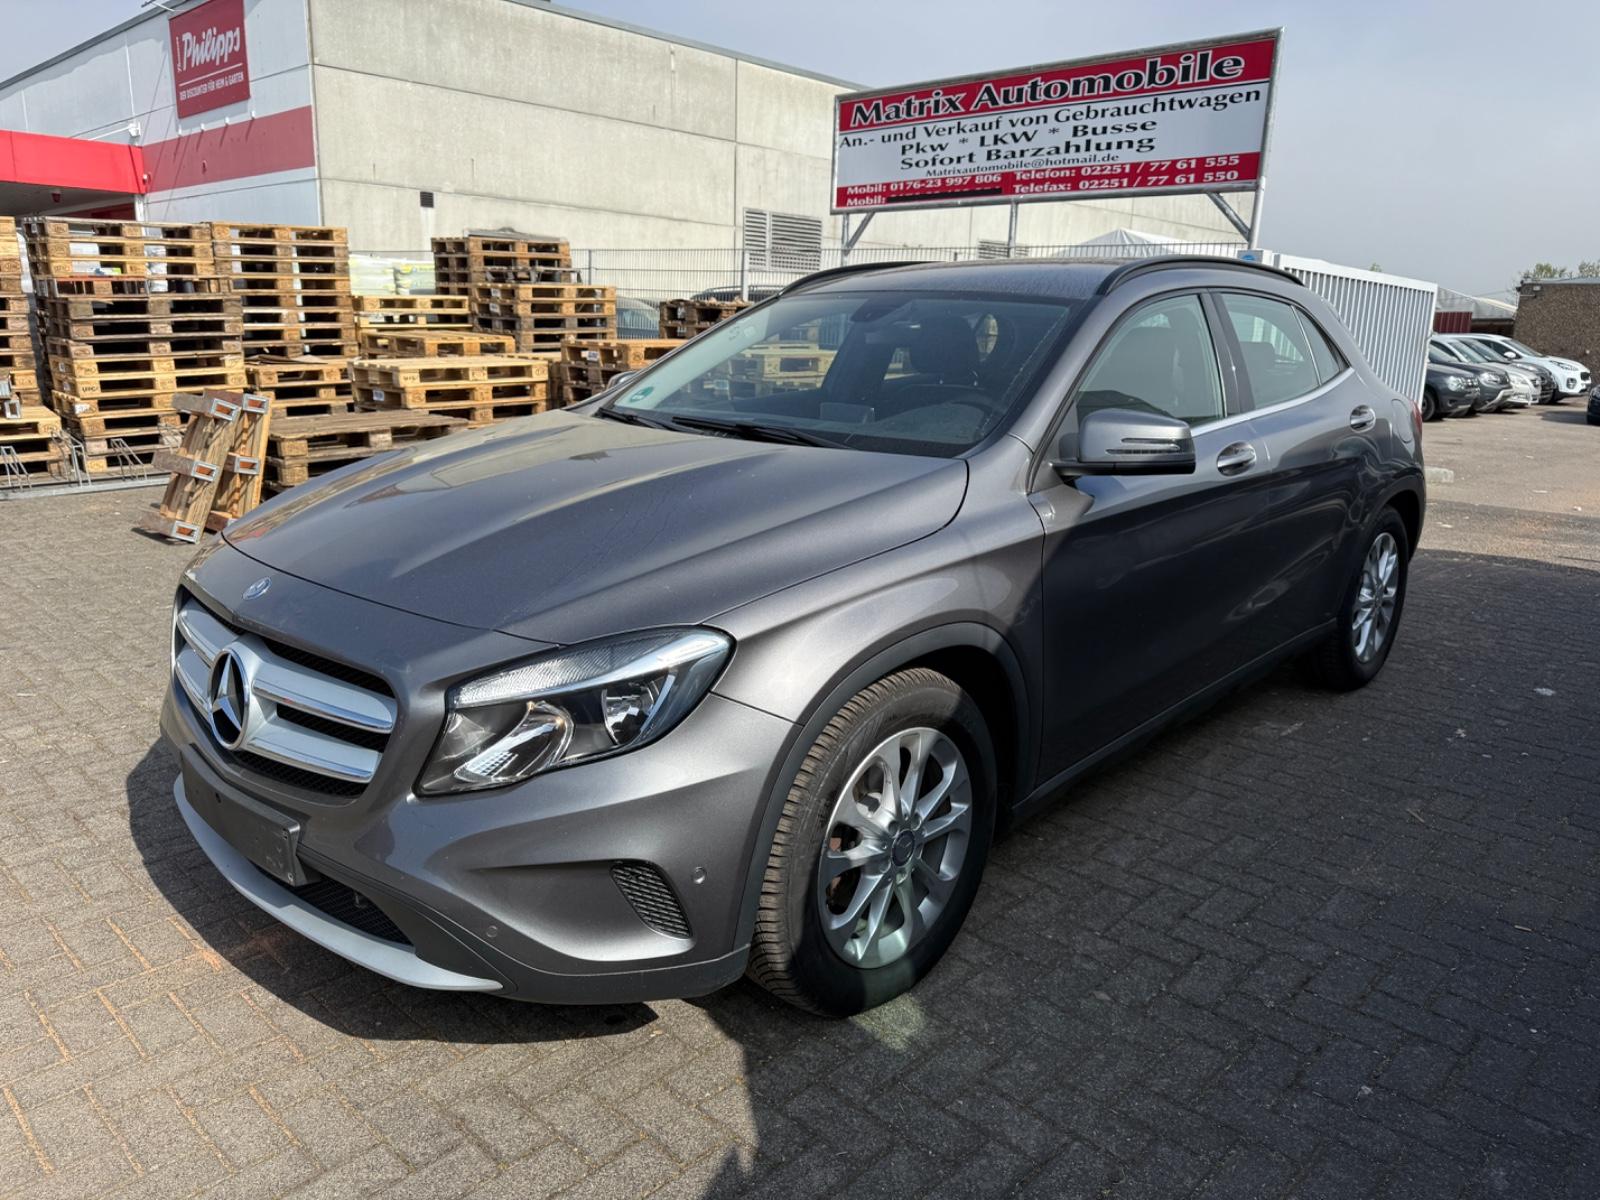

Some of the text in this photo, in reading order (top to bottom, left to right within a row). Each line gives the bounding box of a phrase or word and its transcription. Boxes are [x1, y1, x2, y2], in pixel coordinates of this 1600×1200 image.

[182, 27, 240, 71] Philipps
[850, 50, 1245, 127] Matrix Automobile
[881, 126, 916, 143] und
[923, 116, 1002, 138] Verkauf
[1009, 115, 1048, 128] von
[1054, 90, 1260, 122] Gebrauchtwagen
[901, 120, 1157, 156] Pkw LKW Busse
[900, 137, 1156, 170] Sofort Barzahlung
[926, 153, 1119, 177] Matrixautomobile@hotmail.de
[1014, 155, 1240, 180] Telefon: 02251 / 77 61 555
[847, 184, 886, 195] Mobil:
[890, 179, 942, 191] 0176-23
[945, 176, 971, 187] 997
[975, 174, 1002, 184] 806
[1012, 181, 1072, 194] Telefax:
[1079, 178, 1129, 189] 02251
[1133, 176, 1142, 187] /
[1147, 175, 1169, 186] 77
[1174, 174, 1196, 184] 61
[1203, 170, 1239, 182] 550
[846, 195, 886, 206] Mobil:
